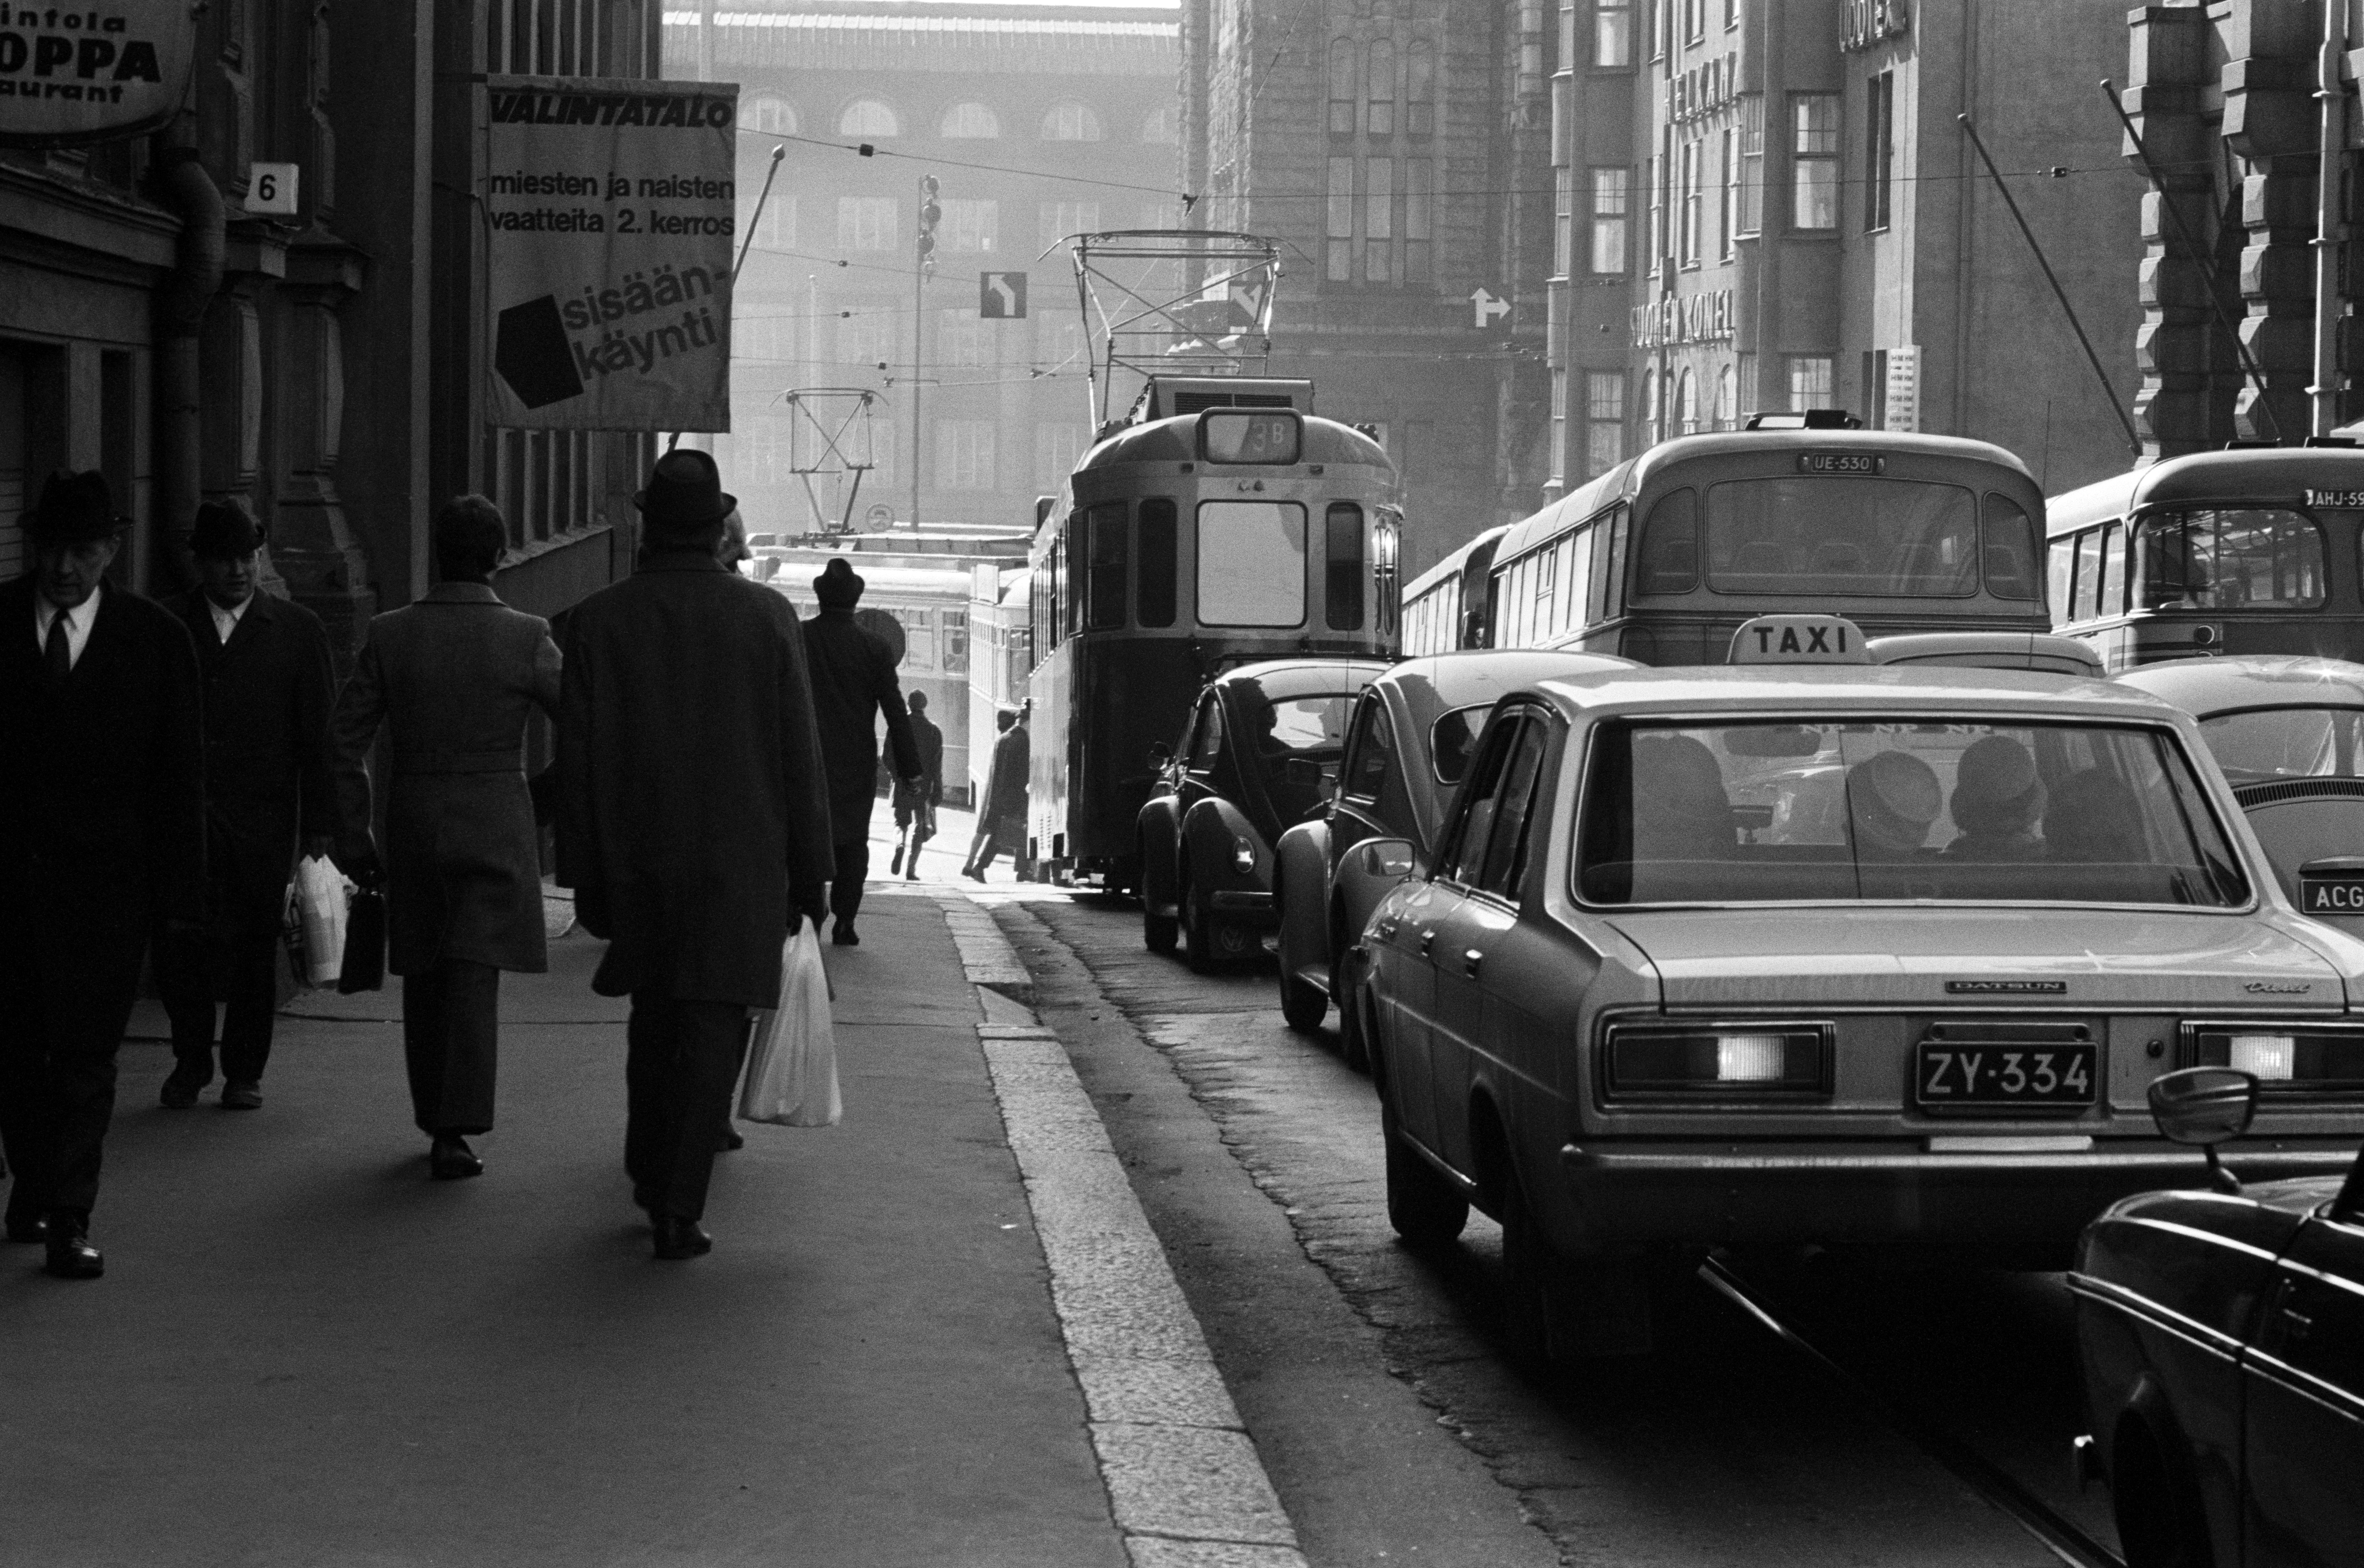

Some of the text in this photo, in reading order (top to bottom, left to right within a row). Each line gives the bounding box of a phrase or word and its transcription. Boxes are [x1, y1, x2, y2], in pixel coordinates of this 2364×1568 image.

[491, 93, 732, 128] VALINTATALO
[258, 174, 276, 201] 6
[491, 170, 735, 201] miesten ja naisten
[490, 208, 735, 236] vaatteita 2. kerros
[572, 307, 717, 380] käynti
[1754, 627, 1846, 653] TAXI
[2316, 886, 2364, 907] ACG
[1927, 1053, 2089, 1094] ZY-334
